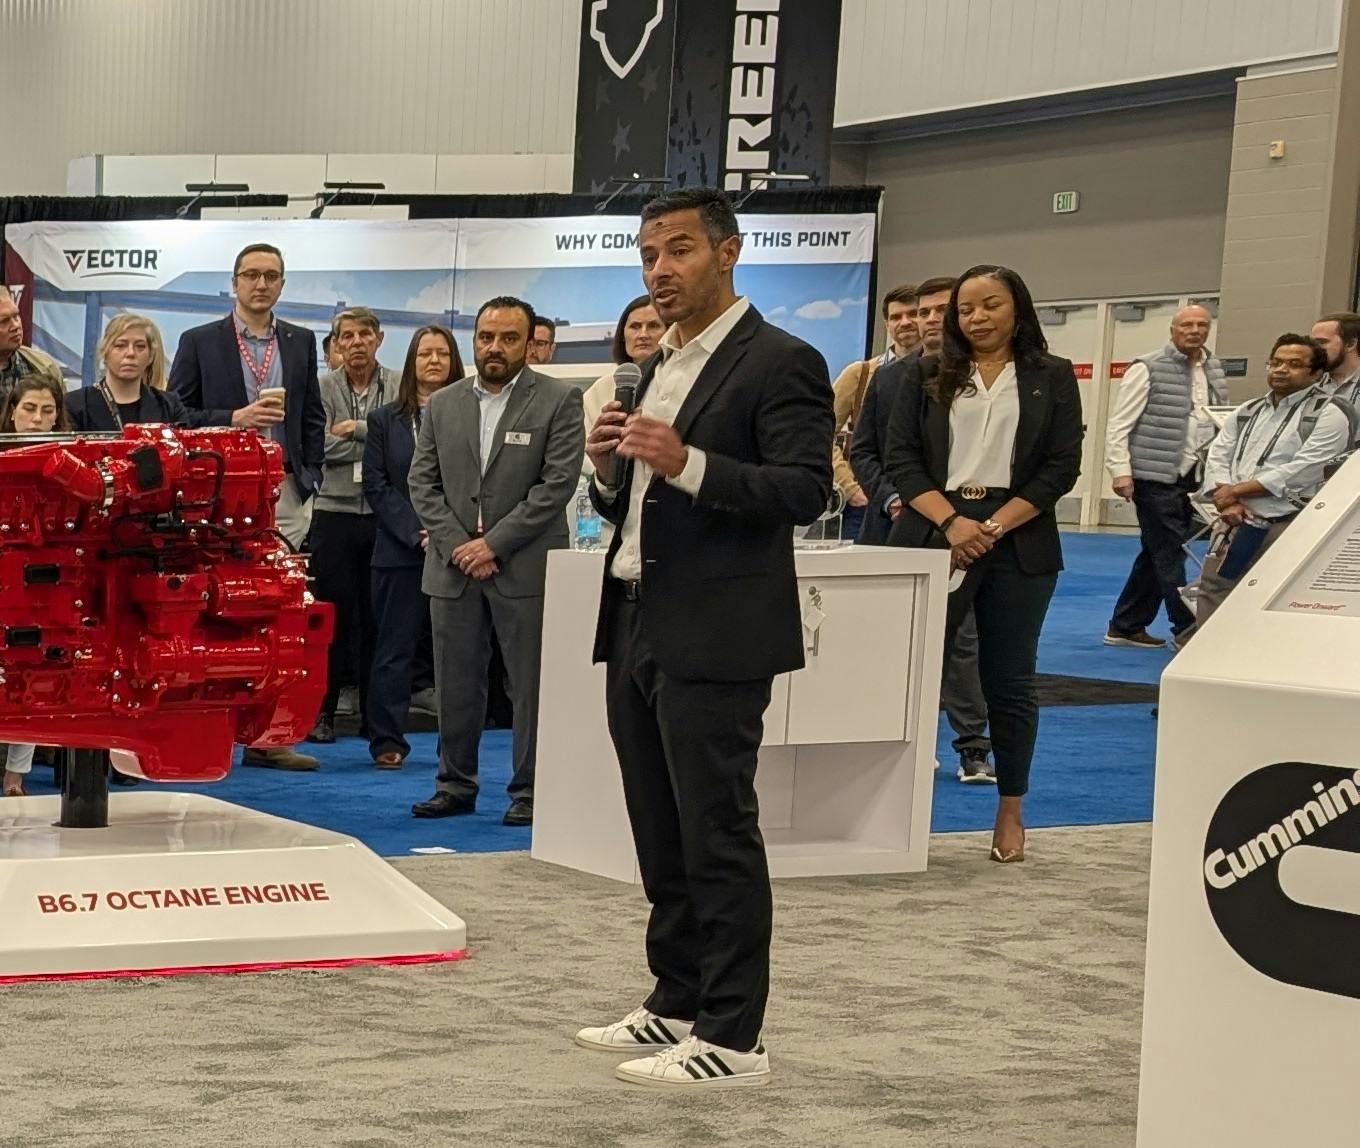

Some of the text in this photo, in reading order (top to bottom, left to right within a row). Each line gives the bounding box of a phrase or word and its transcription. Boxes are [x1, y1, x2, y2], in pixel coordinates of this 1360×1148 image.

[1056, 193, 1073, 210] EXIT
[556, 234, 595, 250] WHY
[601, 232, 641, 250] COM
[752, 231, 792, 247] THIS
[797, 231, 851, 247] POINT
[63, 249, 158, 272] VECTOR
[37, 882, 330, 914] B6.7 OCTANE ENGINE
